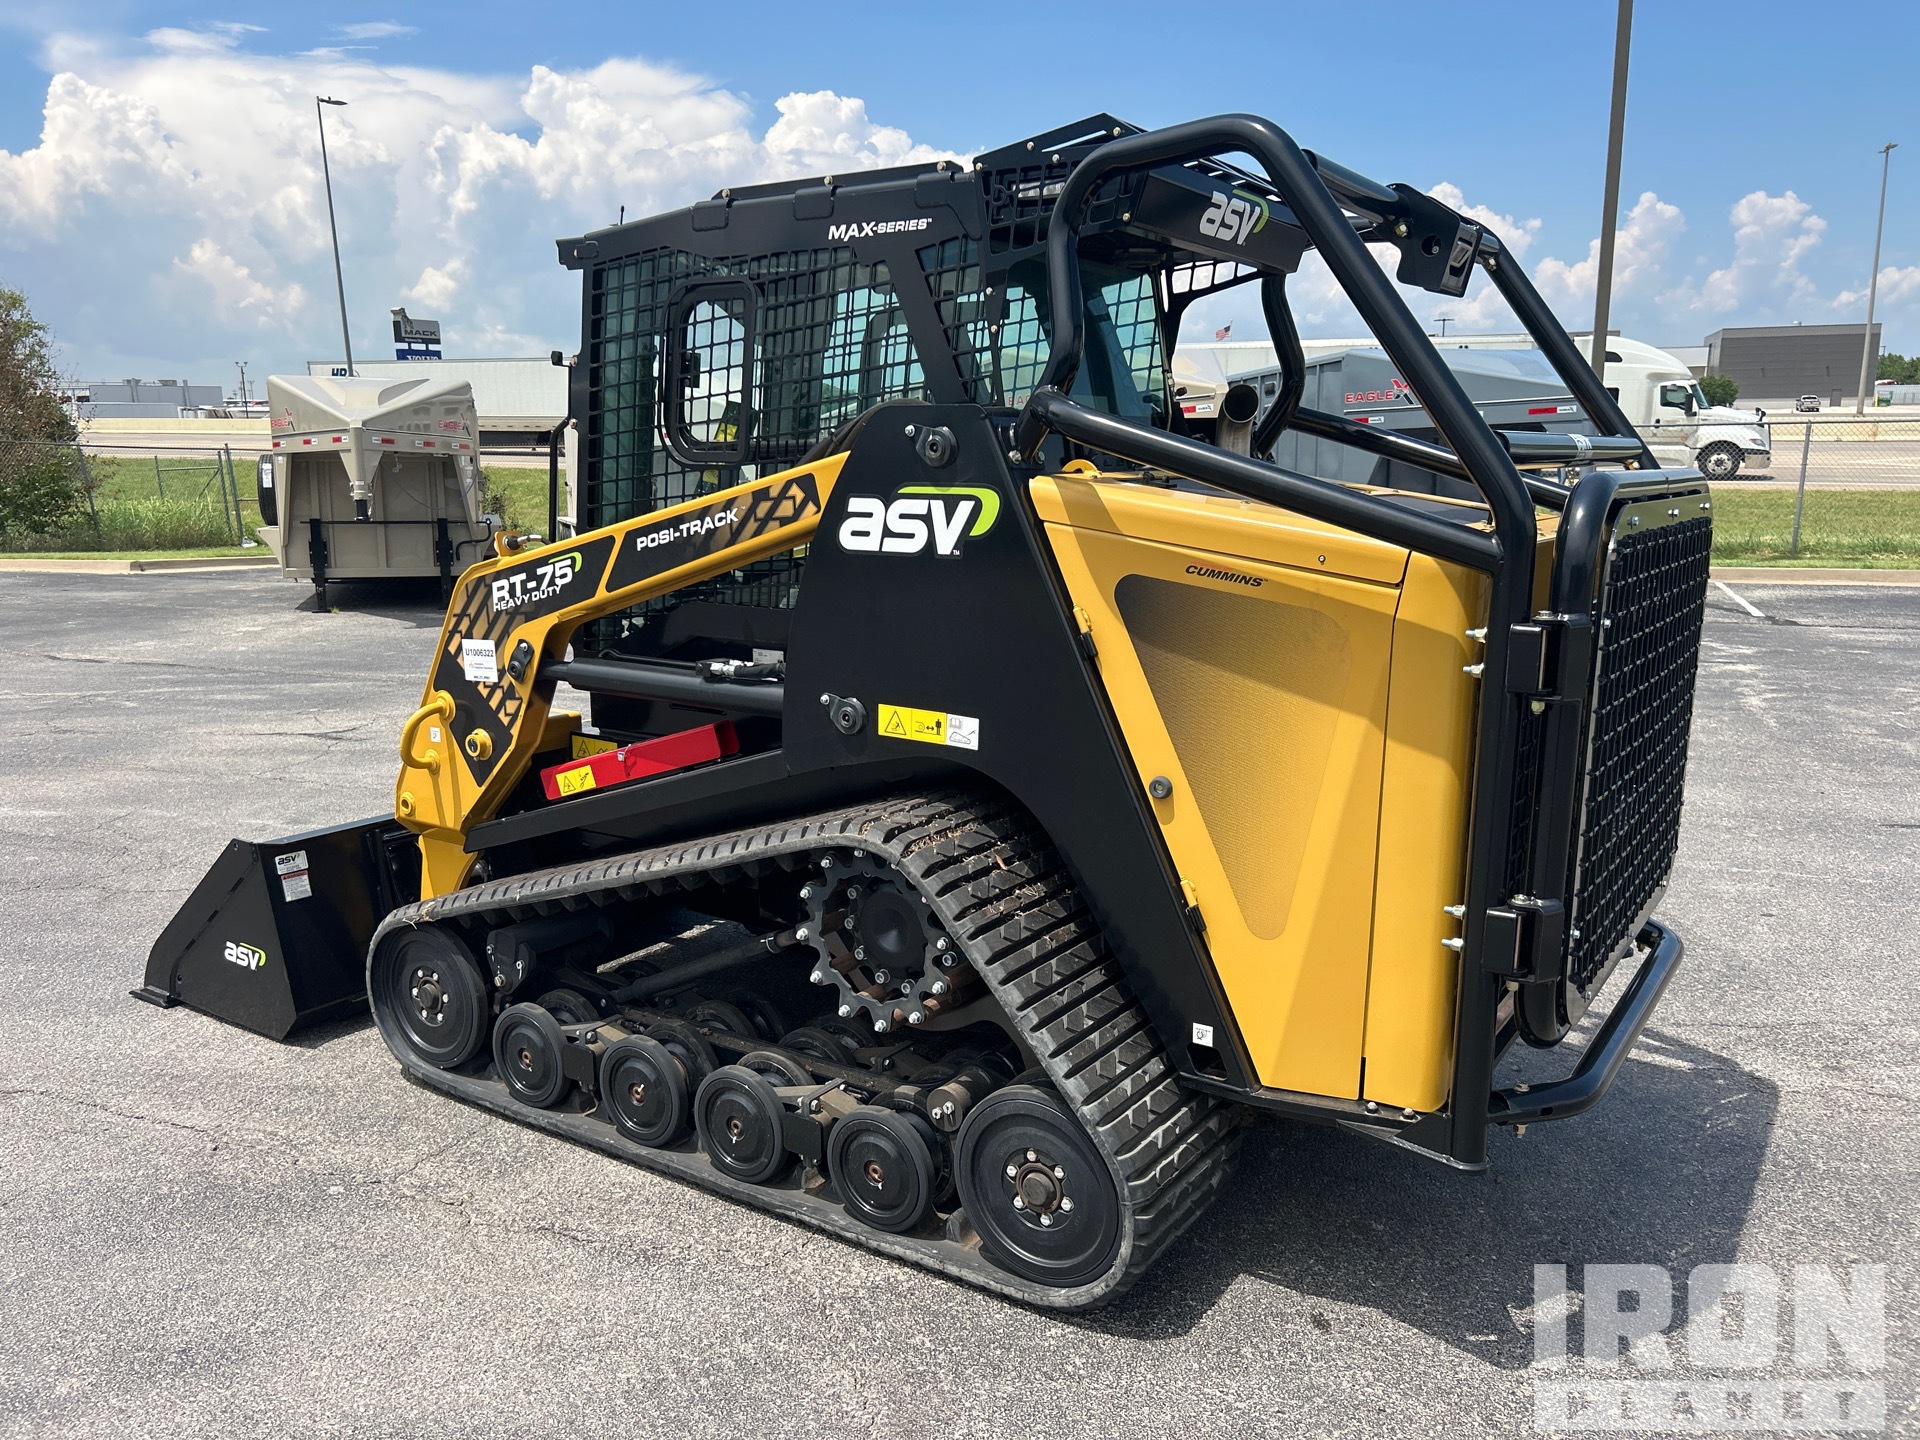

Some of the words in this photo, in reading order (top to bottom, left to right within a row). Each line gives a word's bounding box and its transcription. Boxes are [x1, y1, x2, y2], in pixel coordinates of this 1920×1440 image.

[828, 218, 928, 242] MAX-SERIES
[636, 508, 739, 552] POSI-TRACK
[491, 558, 573, 604] RT-75
[1185, 564, 1264, 587] CUMMINS
[493, 593, 531, 612] HEAVY
[531, 584, 562, 602] DUTY
